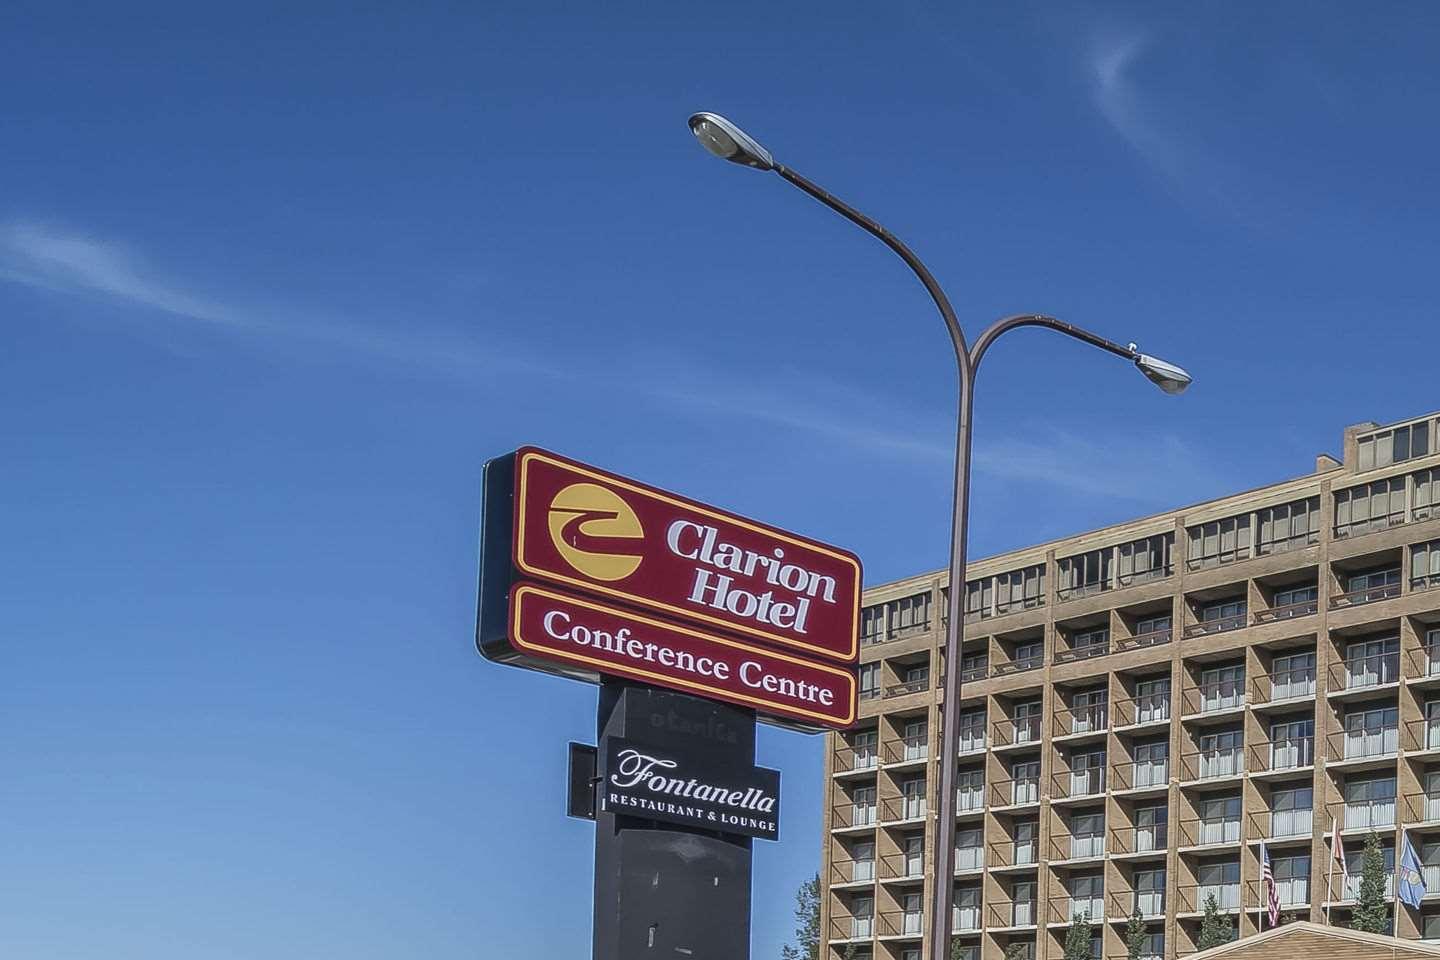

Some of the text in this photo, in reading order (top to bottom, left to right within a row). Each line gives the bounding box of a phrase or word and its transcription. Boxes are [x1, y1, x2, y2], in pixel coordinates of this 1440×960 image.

[666, 519, 837, 604] Clarion
[687, 567, 811, 634] Hotel
[542, 609, 834, 707] Conference Centre
[610, 749, 777, 813] Fontanella
[610, 792, 777, 832] RESTAURANT & LOUNGE
